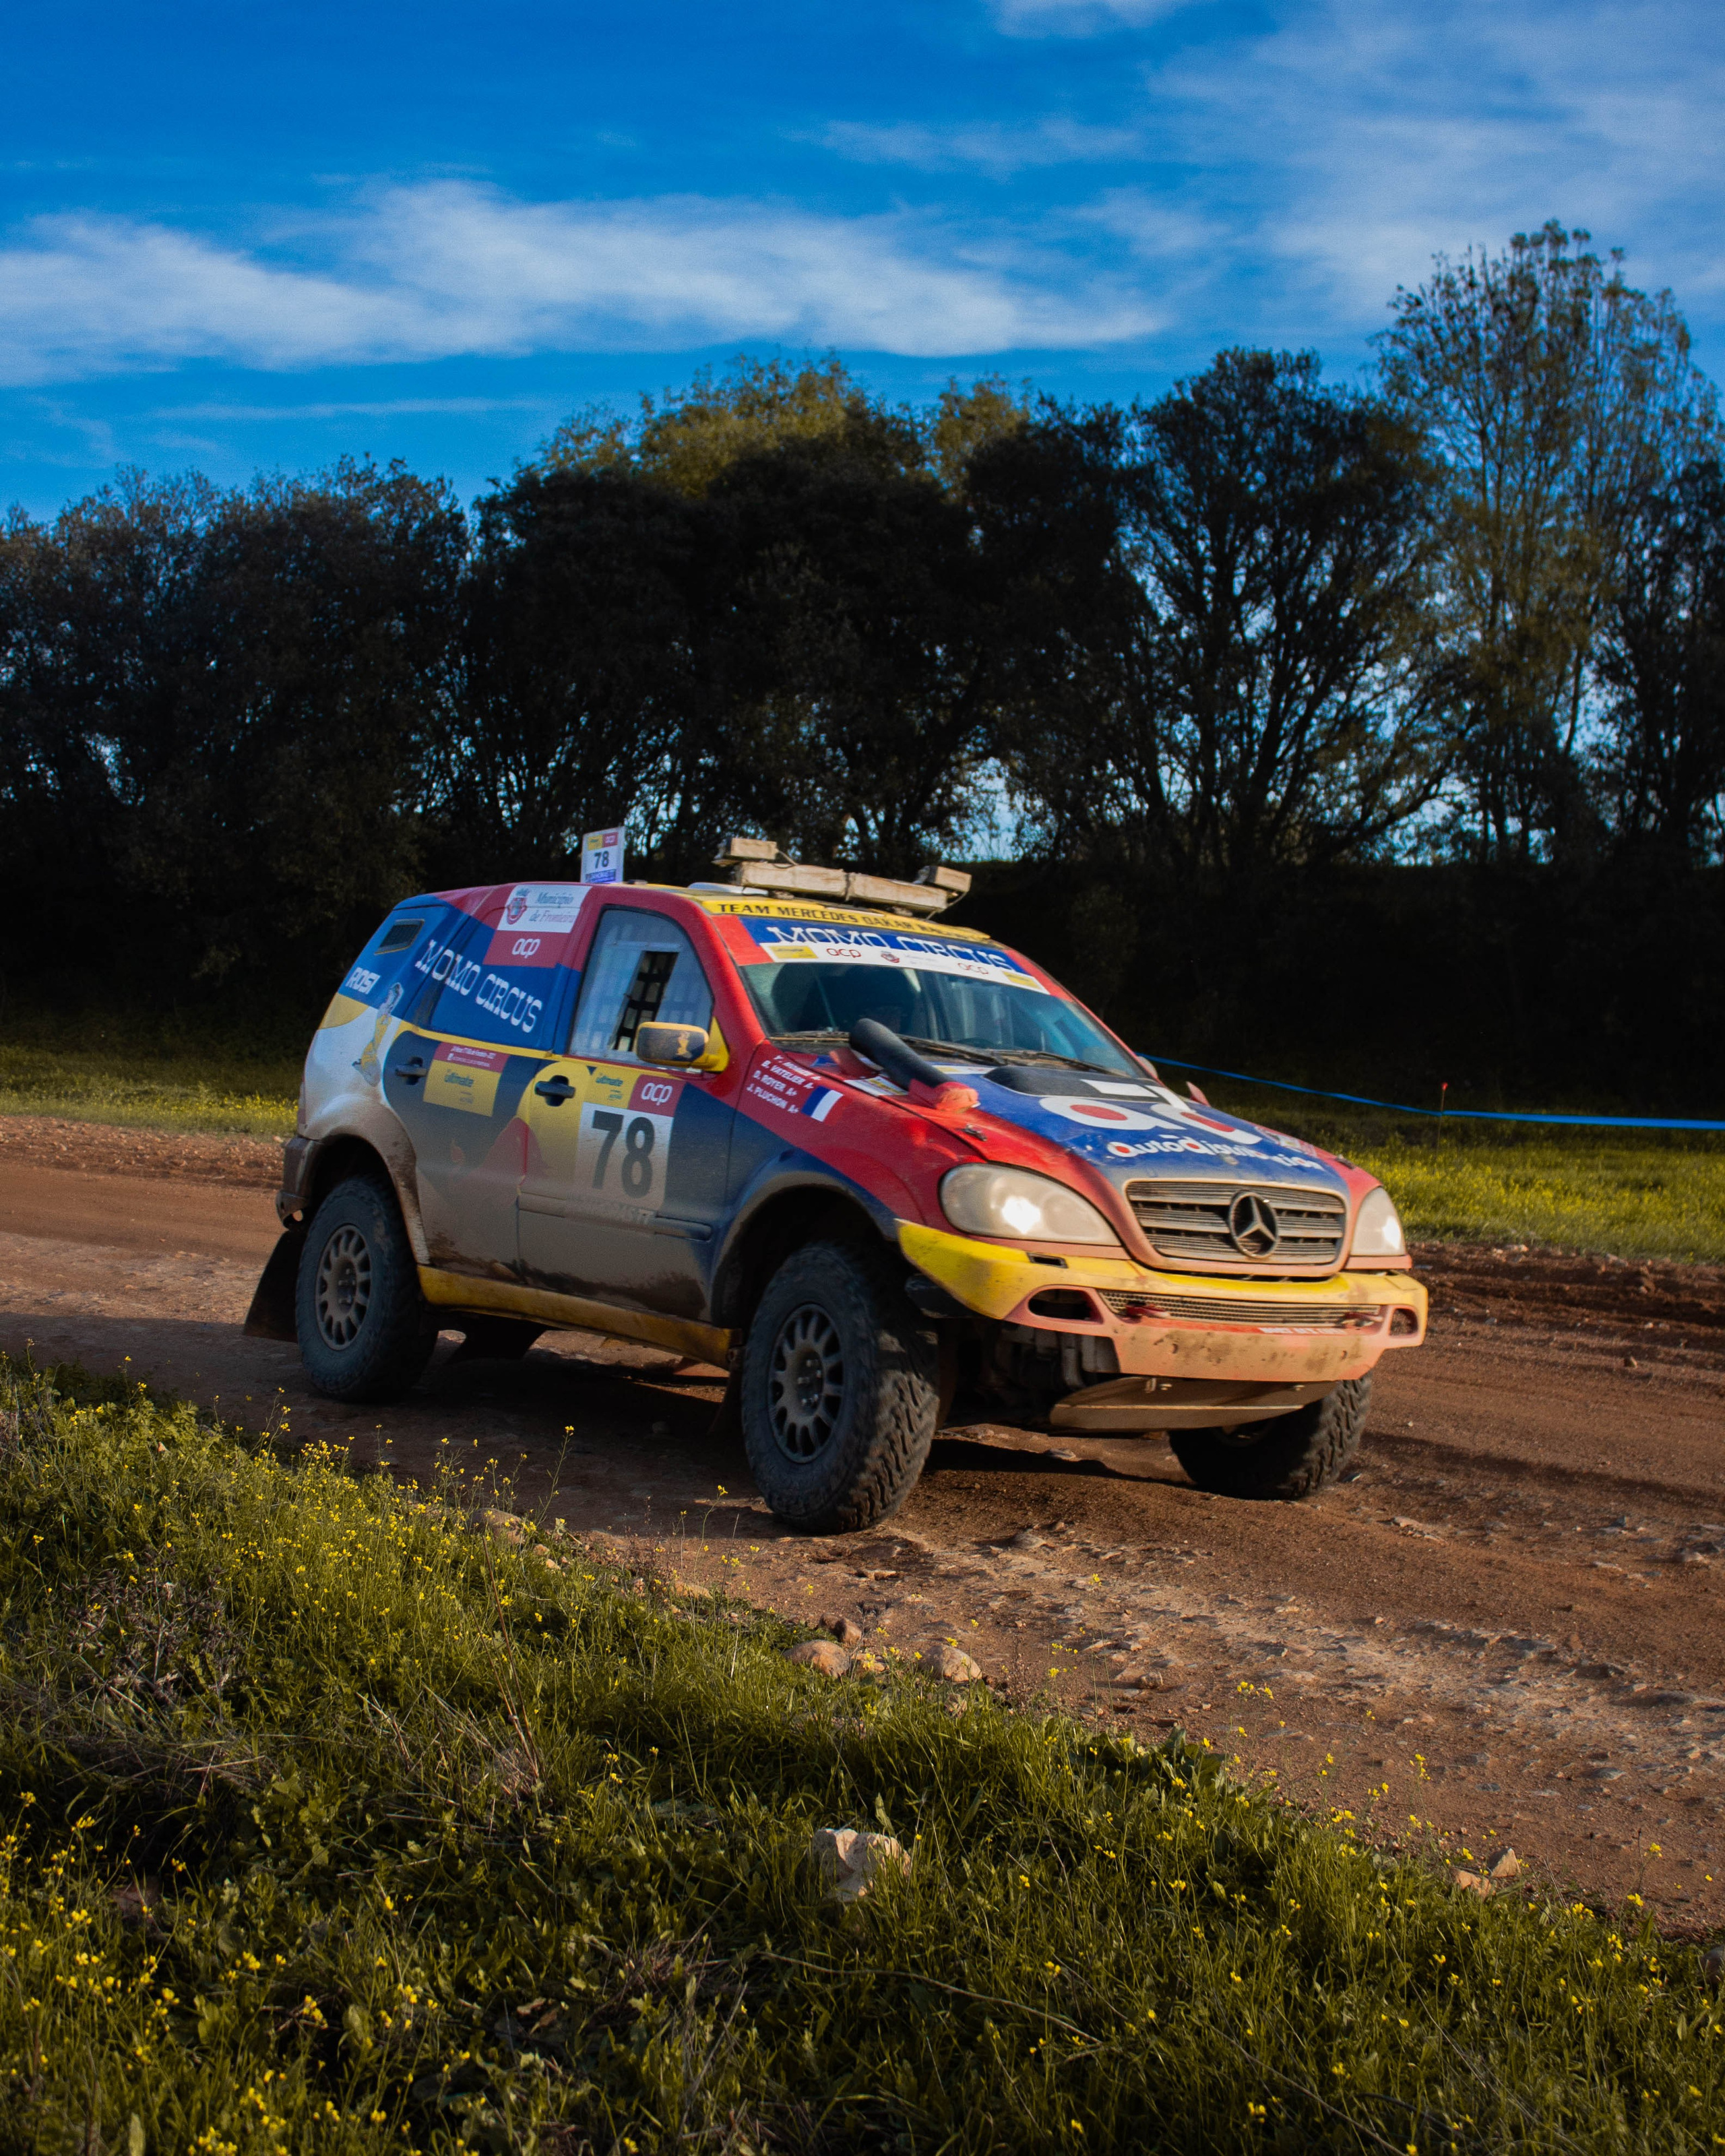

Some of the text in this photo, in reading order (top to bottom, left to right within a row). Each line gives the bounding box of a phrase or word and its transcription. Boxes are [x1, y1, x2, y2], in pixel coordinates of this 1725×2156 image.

[594, 851, 609, 868] 78
[718, 903, 770, 914] TEAM
[777, 907, 858, 922] MERCEDES
[766, 926, 891, 949] MOMO
[414, 939, 542, 1034] MOMO CIRCUS
[592, 1110, 655, 1199] 78
